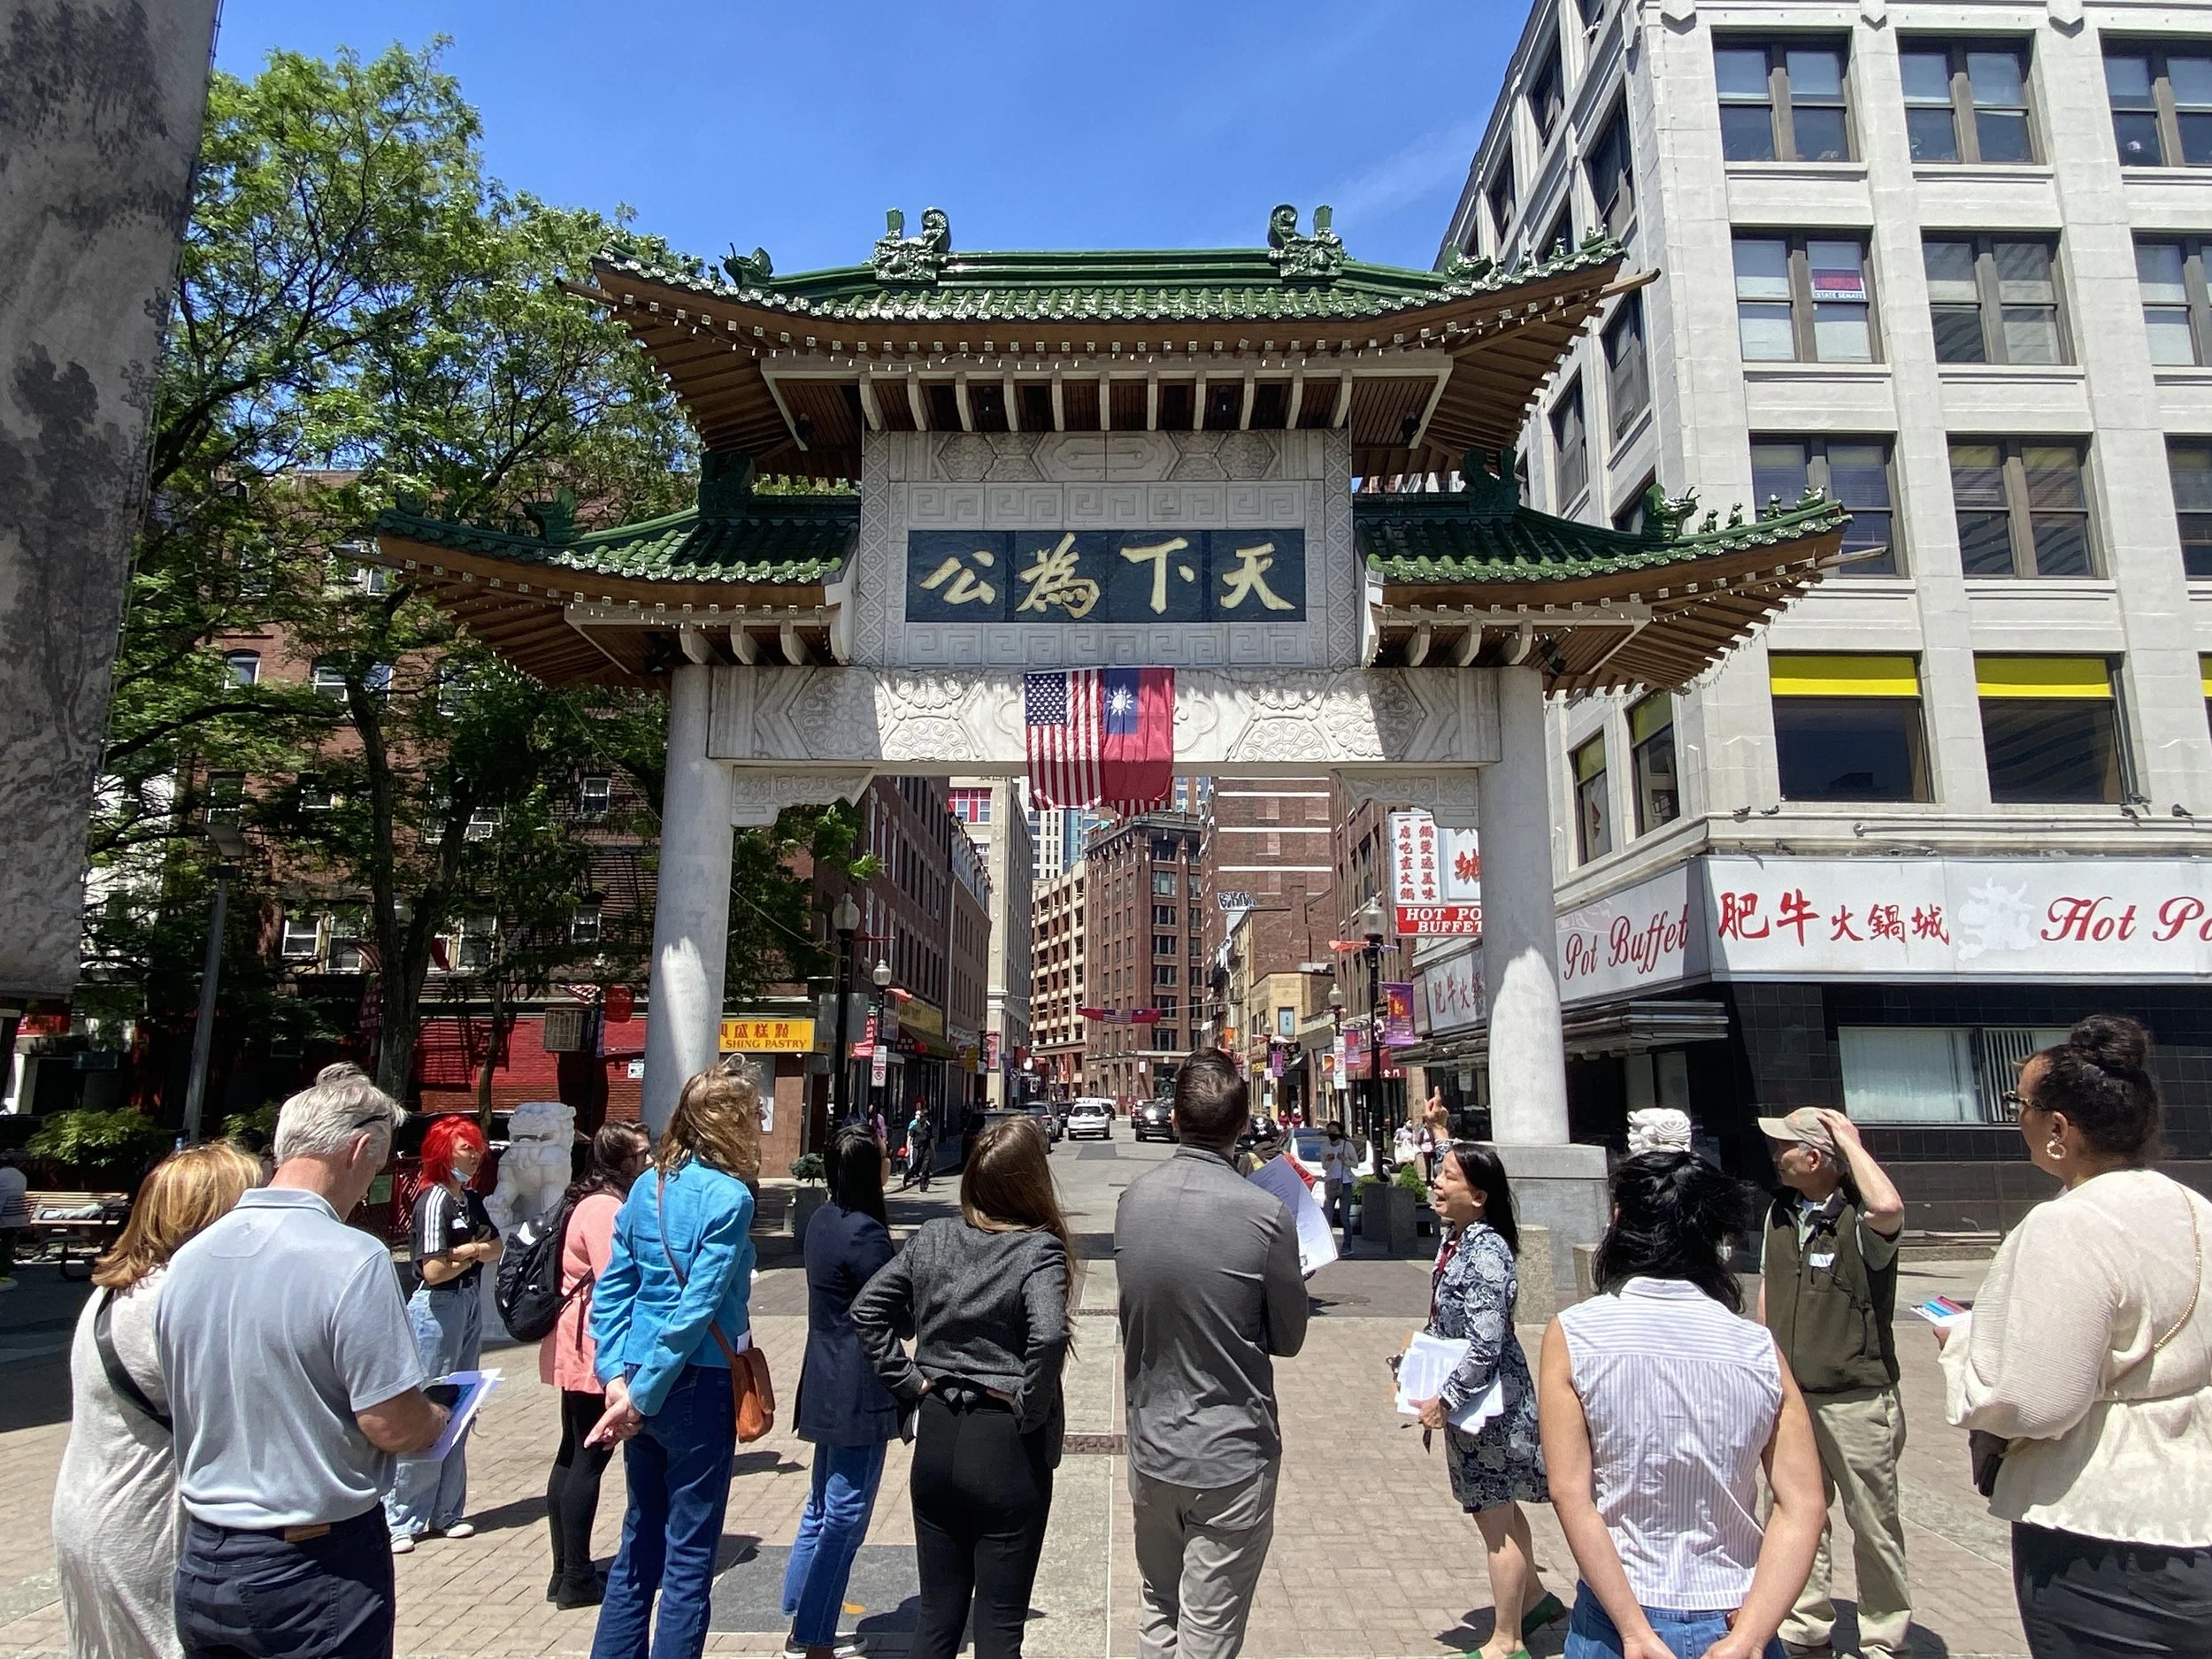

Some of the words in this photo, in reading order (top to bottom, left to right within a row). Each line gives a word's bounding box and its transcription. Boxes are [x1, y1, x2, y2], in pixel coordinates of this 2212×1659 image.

[1405, 908, 1446, 921] HOT
[1718, 887, 1950, 948] 肥牛火鍋城
[2040, 896, 2137, 941] Hot
[1564, 933, 1598, 980] Pot
[1608, 903, 1689, 975] Buffet
[726, 1039, 760, 1048] SHING
[764, 1039, 807, 1048] PASTRY
